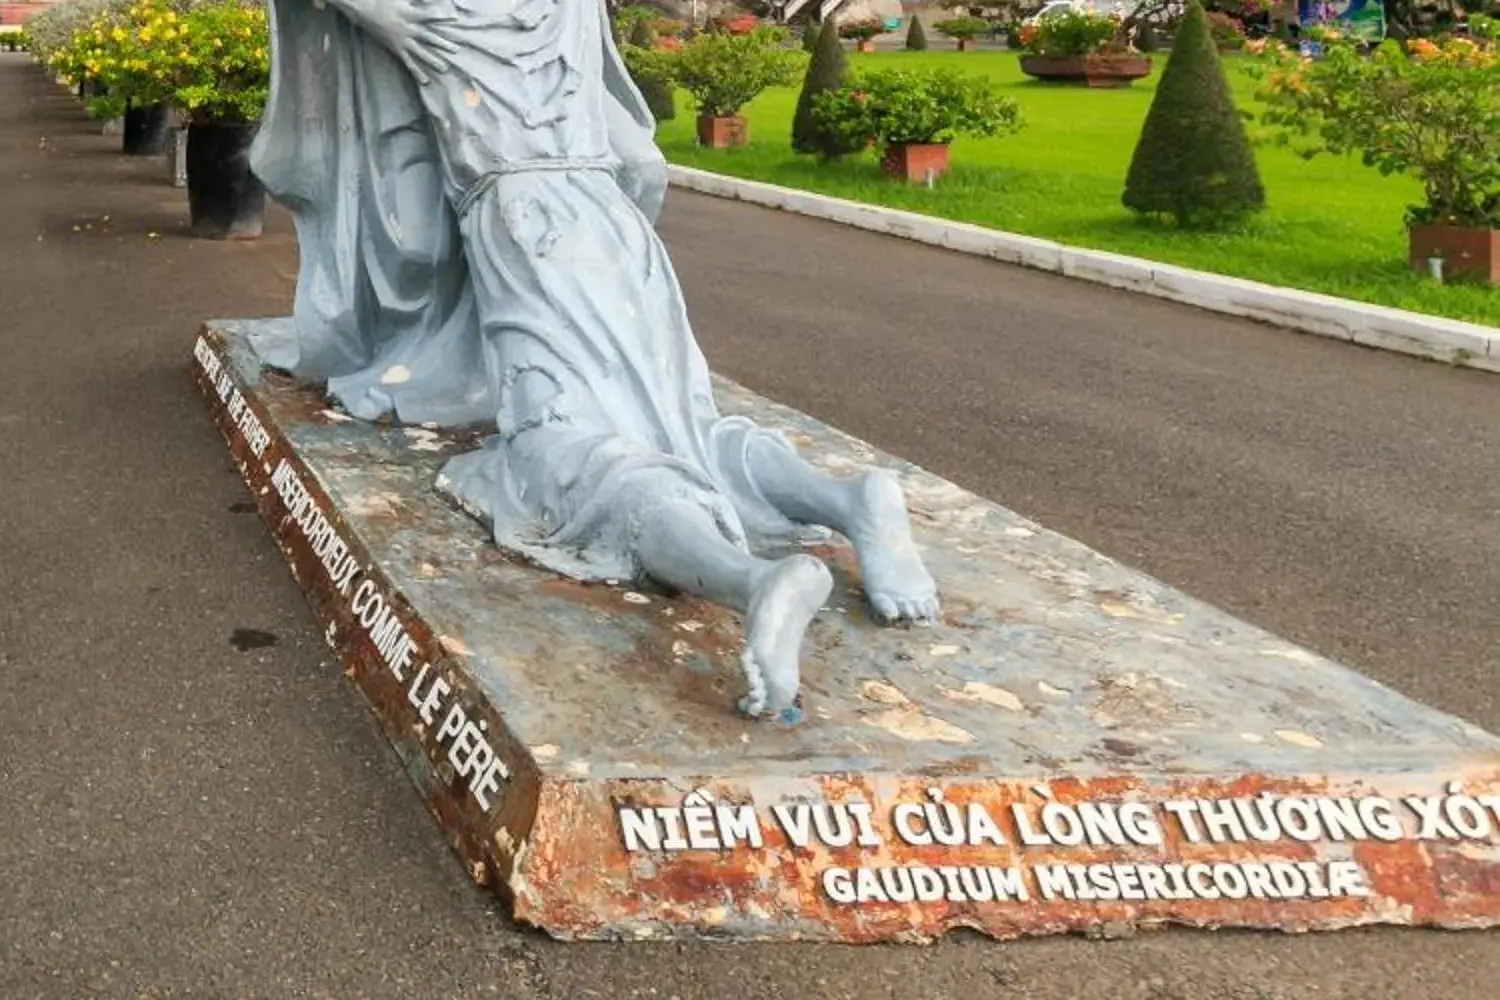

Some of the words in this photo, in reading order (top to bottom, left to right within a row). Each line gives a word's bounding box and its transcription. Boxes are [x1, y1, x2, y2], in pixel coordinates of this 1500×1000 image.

[352, 579, 419, 682] COMME
[408, 663, 450, 726] LE
[775, 803, 881, 848] VUI
[893, 787, 1009, 846] CỦA
[1010, 785, 1162, 846] LÒNG
[823, 866, 1029, 903] GAUDIUM
